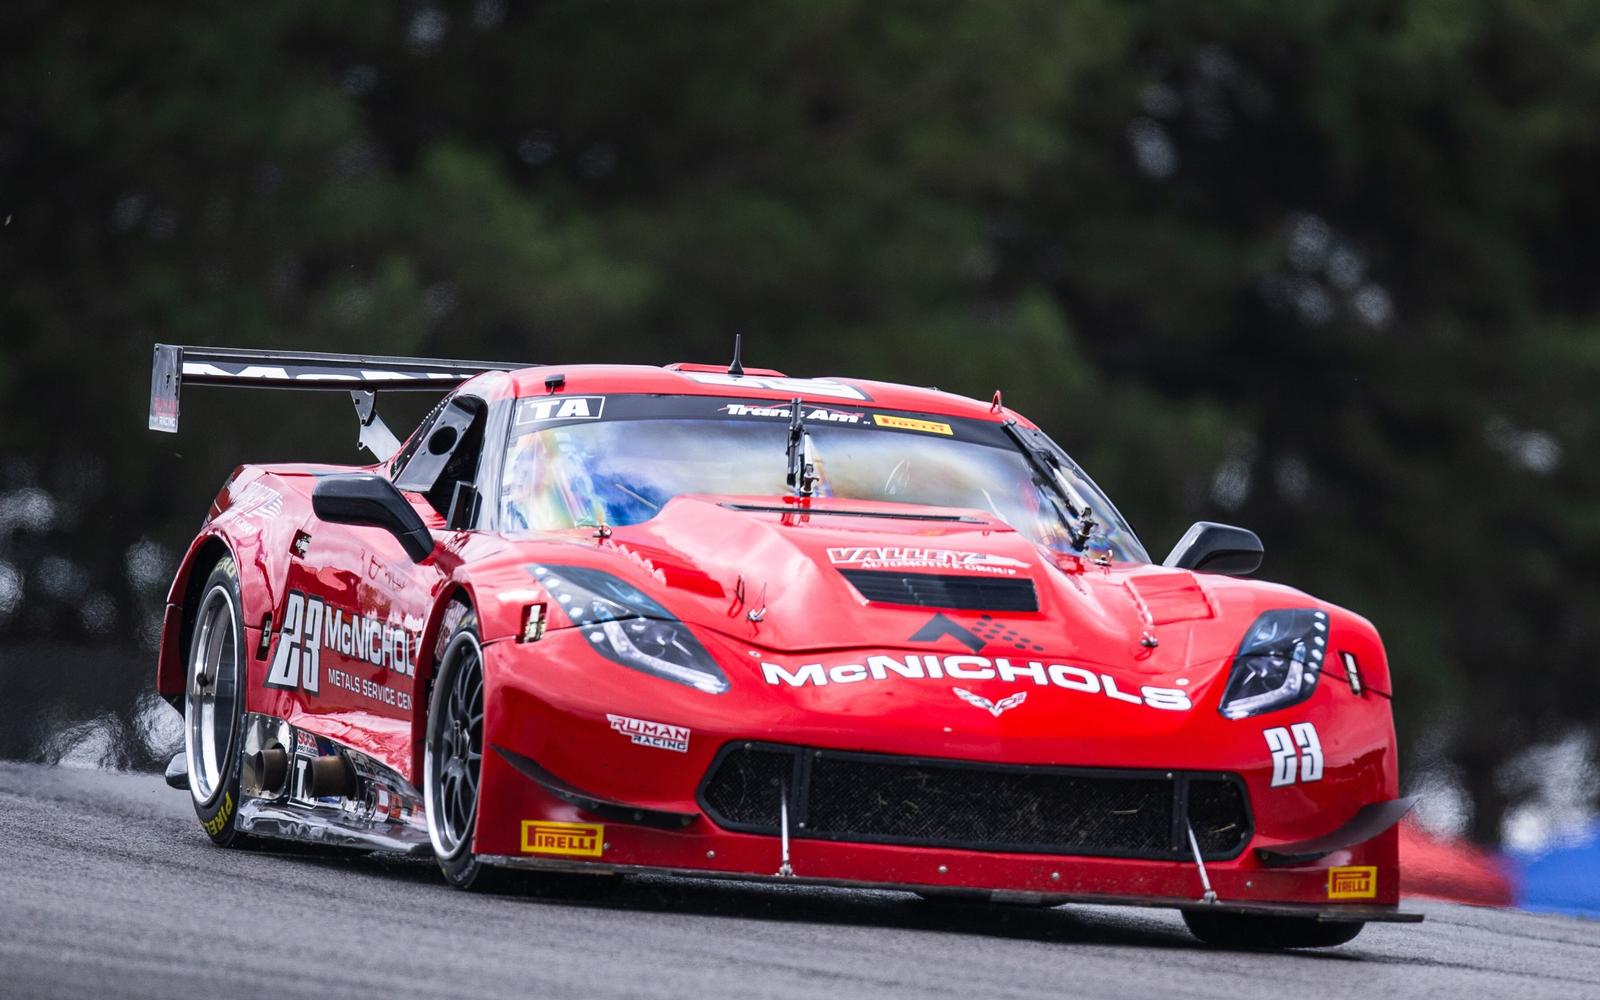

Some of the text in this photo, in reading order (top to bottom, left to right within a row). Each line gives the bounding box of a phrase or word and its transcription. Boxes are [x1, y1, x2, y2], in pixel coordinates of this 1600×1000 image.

[530, 398, 591, 420] TA
[806, 408, 859, 423] Am
[826, 546, 976, 565] VALLEY
[267, 592, 324, 693] 23
[328, 667, 361, 694] METALS
[361, 678, 396, 706] SERVICE
[760, 654, 1193, 712] McNICHOLS
[609, 717, 688, 740] RUMAN
[632, 734, 687, 751] RACING
[1262, 721, 1324, 787] 23
[527, 825, 598, 851] PIRELLI
[1332, 871, 1371, 893] PIRELLI
